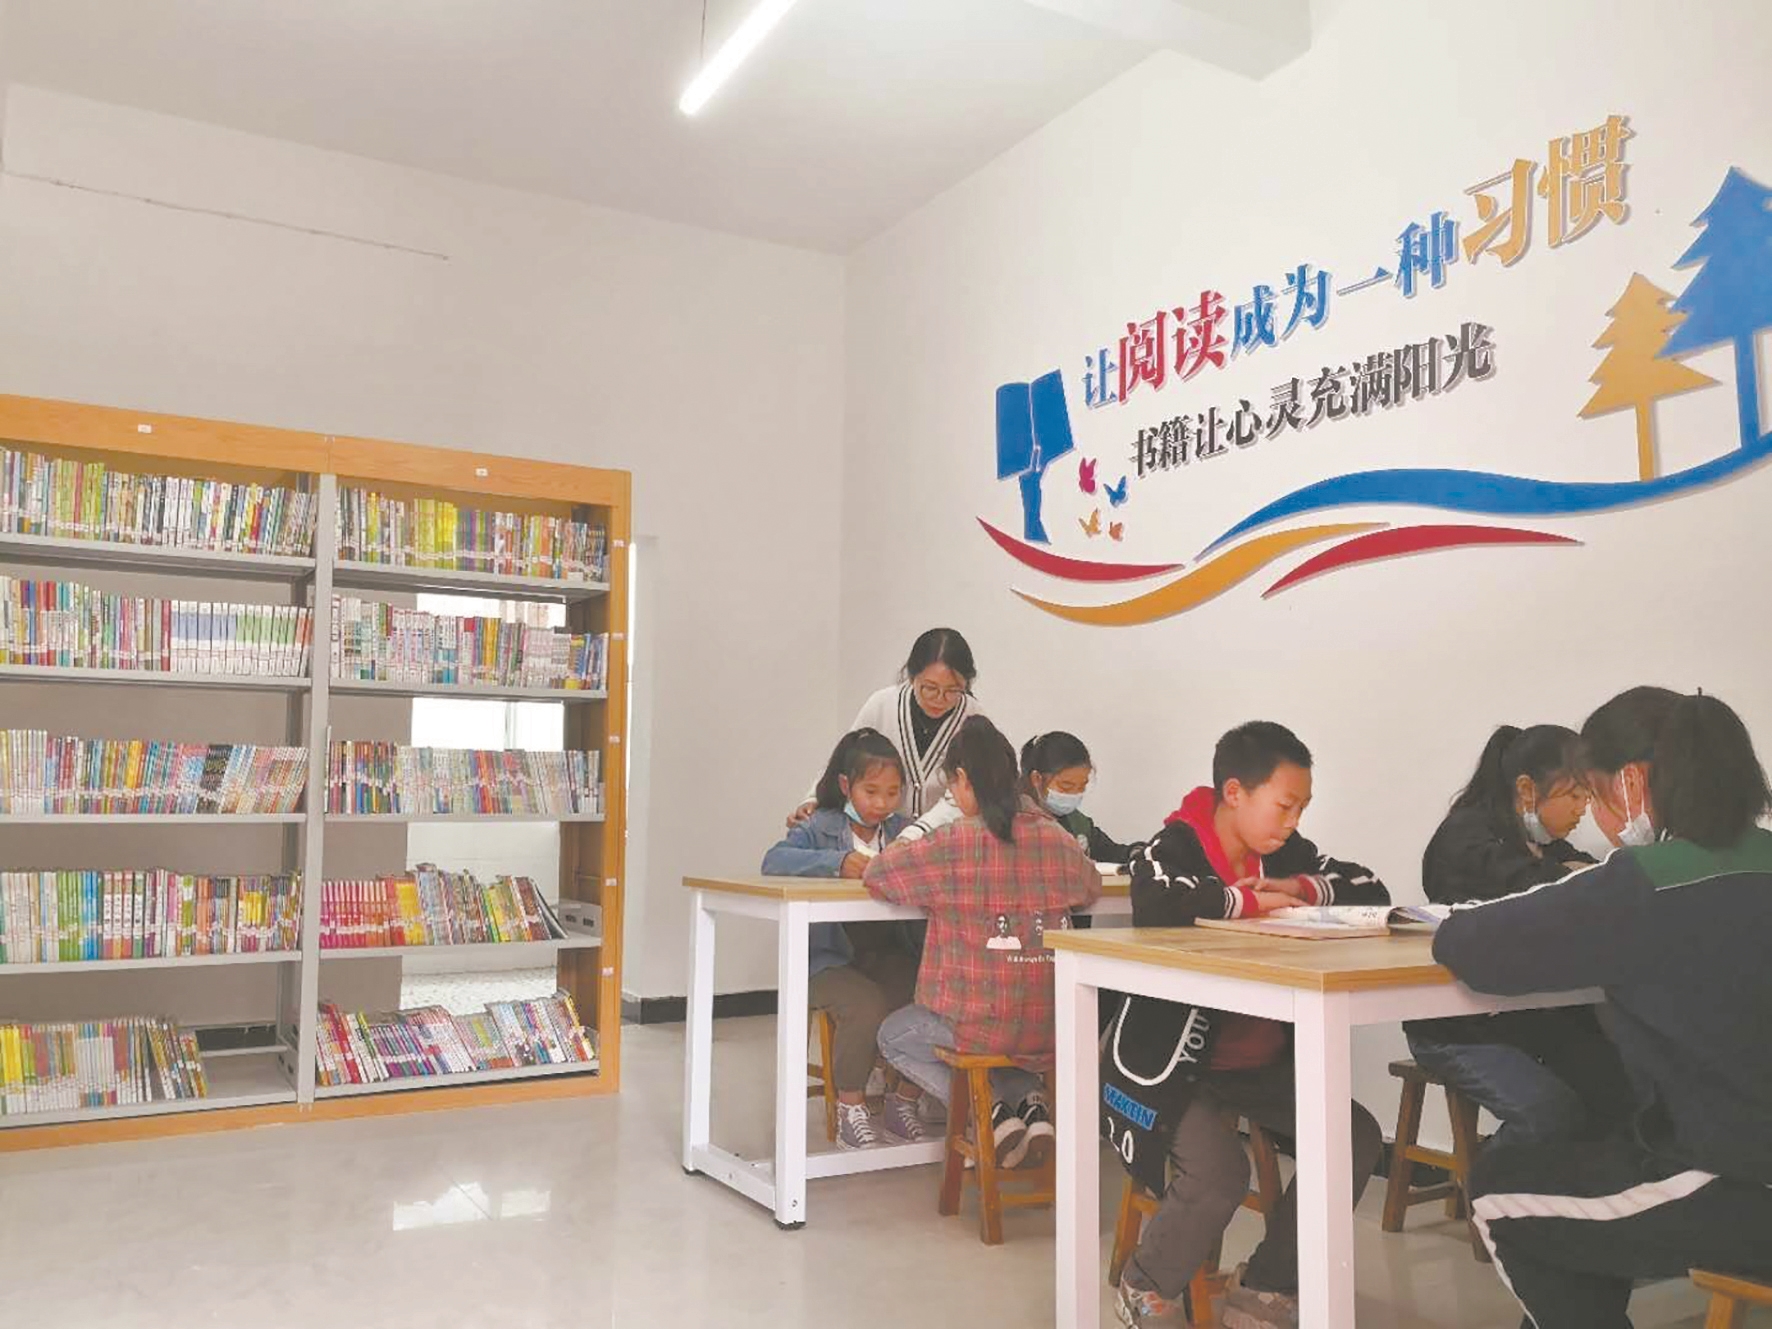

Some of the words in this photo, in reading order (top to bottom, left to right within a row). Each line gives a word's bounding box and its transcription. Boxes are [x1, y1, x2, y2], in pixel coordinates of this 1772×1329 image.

[1082, 115, 1634, 409] 让阅读成为一种习惯
[1130, 322, 1496, 478] 书籍让心灵充满阳光
